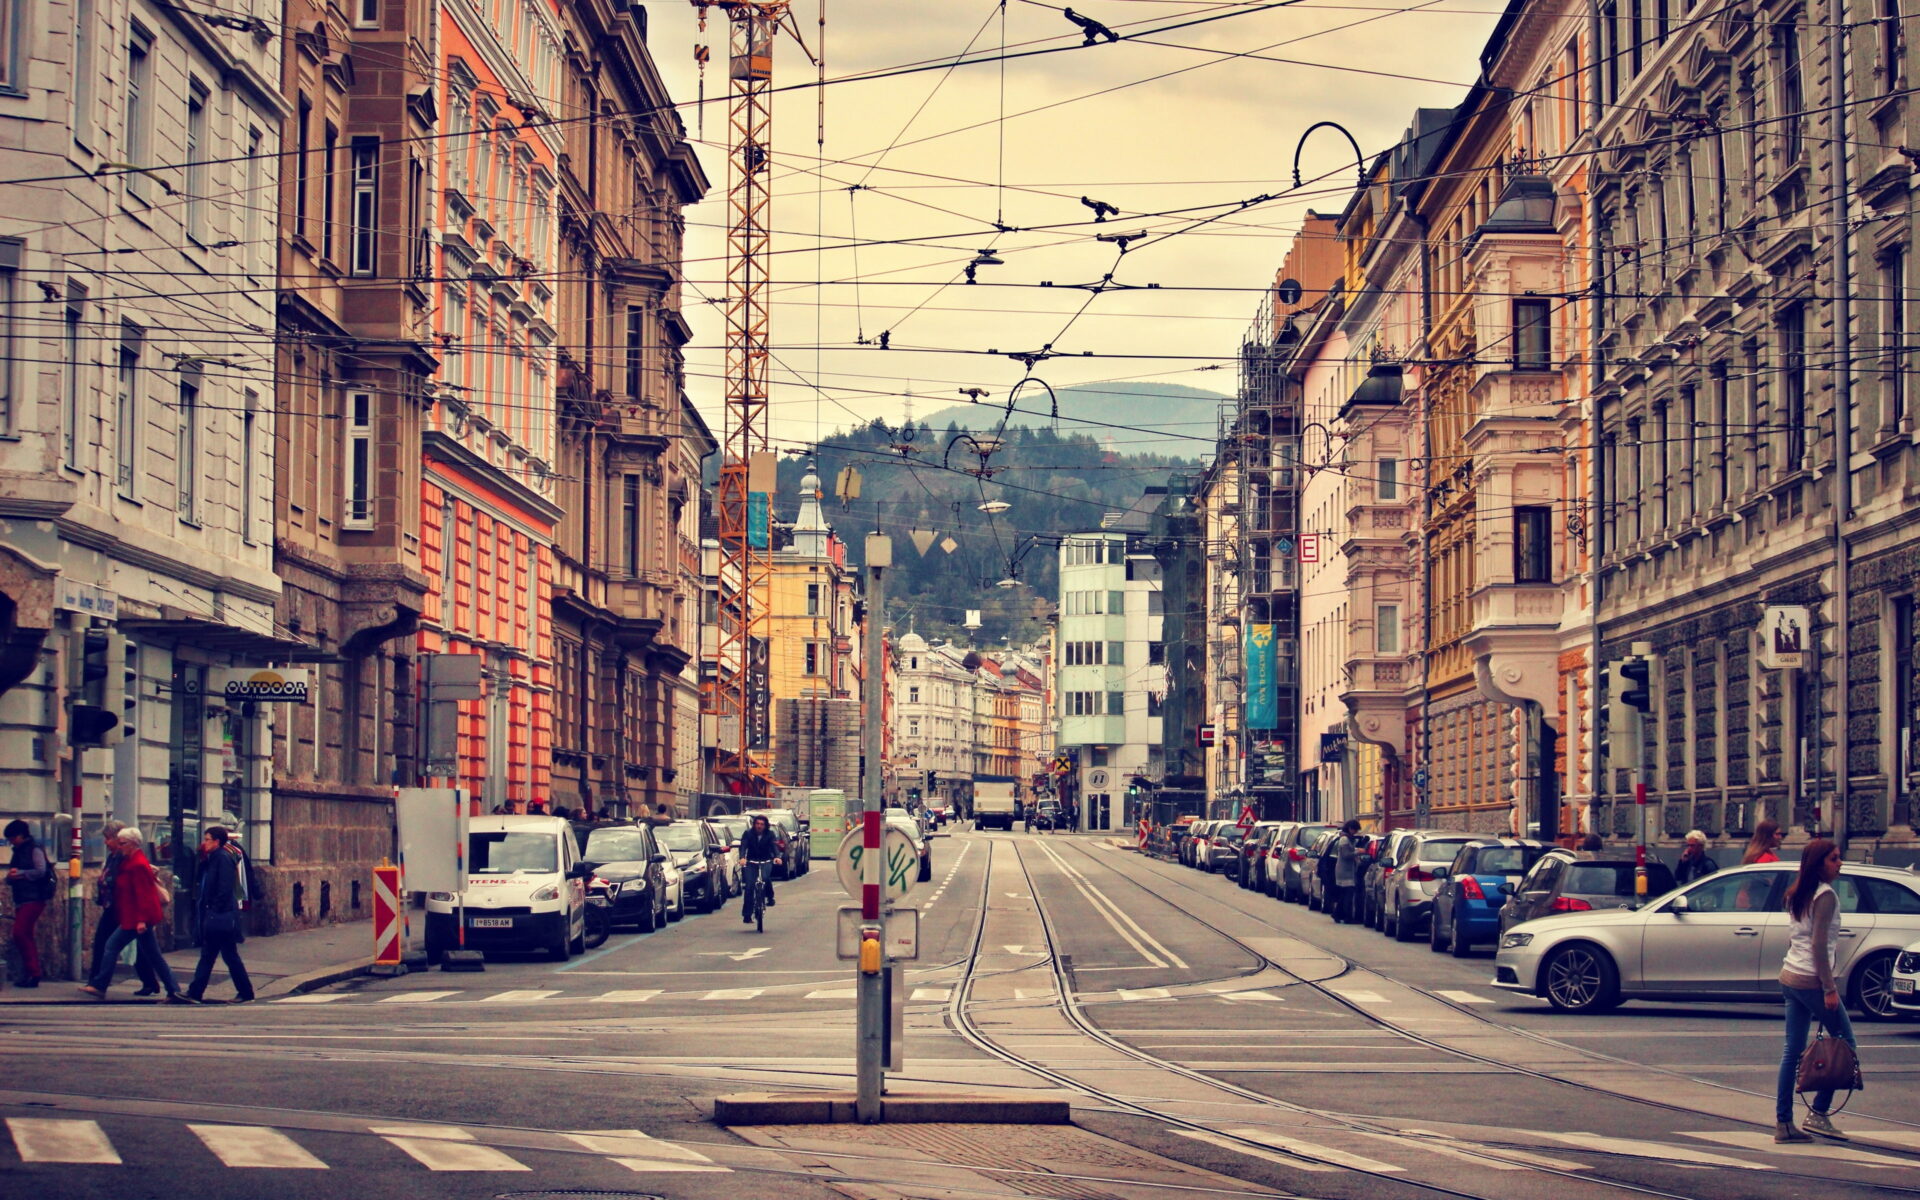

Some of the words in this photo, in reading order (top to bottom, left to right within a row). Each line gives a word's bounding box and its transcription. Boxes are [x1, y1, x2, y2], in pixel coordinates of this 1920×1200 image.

[1303, 539, 1315, 557] E
[227, 681, 305, 694] OUTDOOR
[755, 674, 764, 744] umfeld
